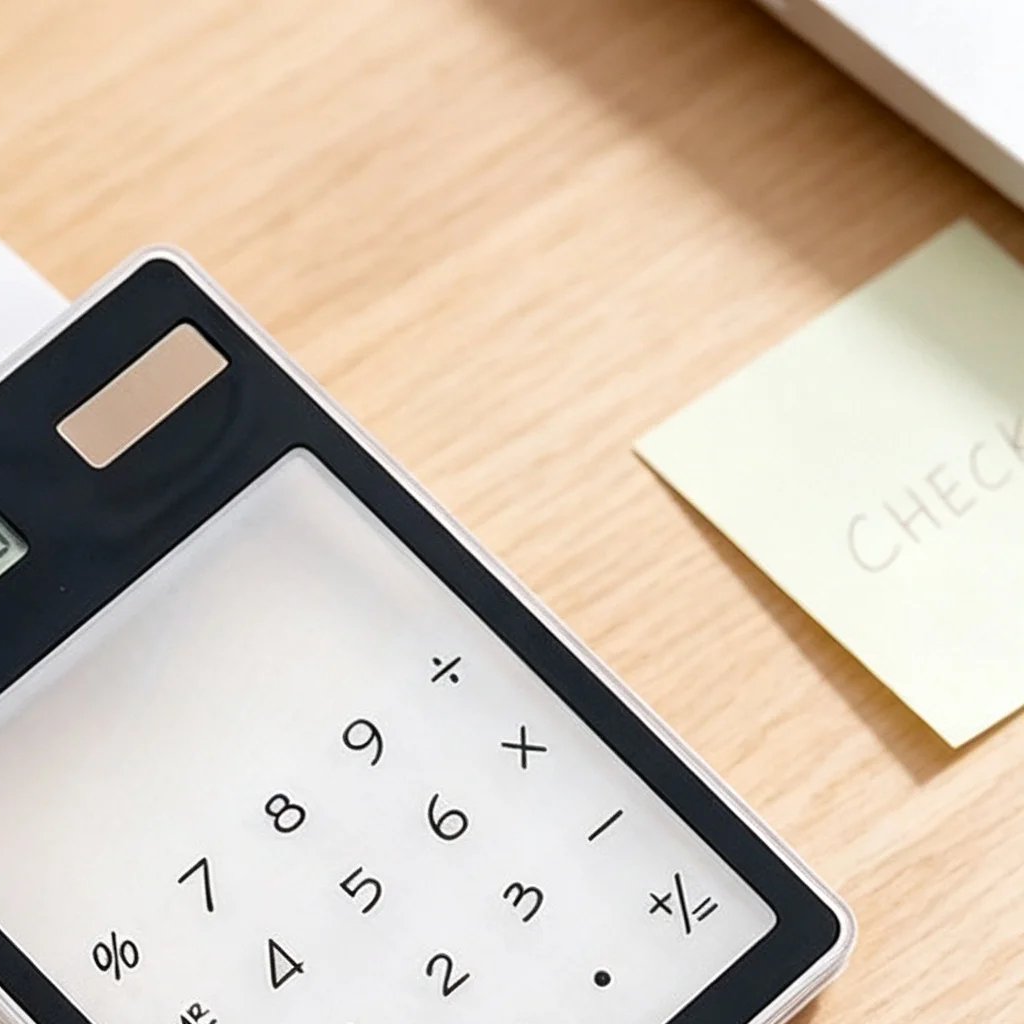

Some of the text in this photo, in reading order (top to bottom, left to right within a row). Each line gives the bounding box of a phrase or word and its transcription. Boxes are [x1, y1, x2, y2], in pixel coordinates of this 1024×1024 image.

[90, 929, 141, 983] %
[176, 855, 216, 914] 7
[263, 791, 308, 835] 8
[340, 717, 385, 768] 9
[266, 936, 306, 991] 4
[337, 865, 384, 916] 5
[426, 791, 470, 843] 6
[424, 951, 472, 999] 2
[501, 880, 546, 925] 3
